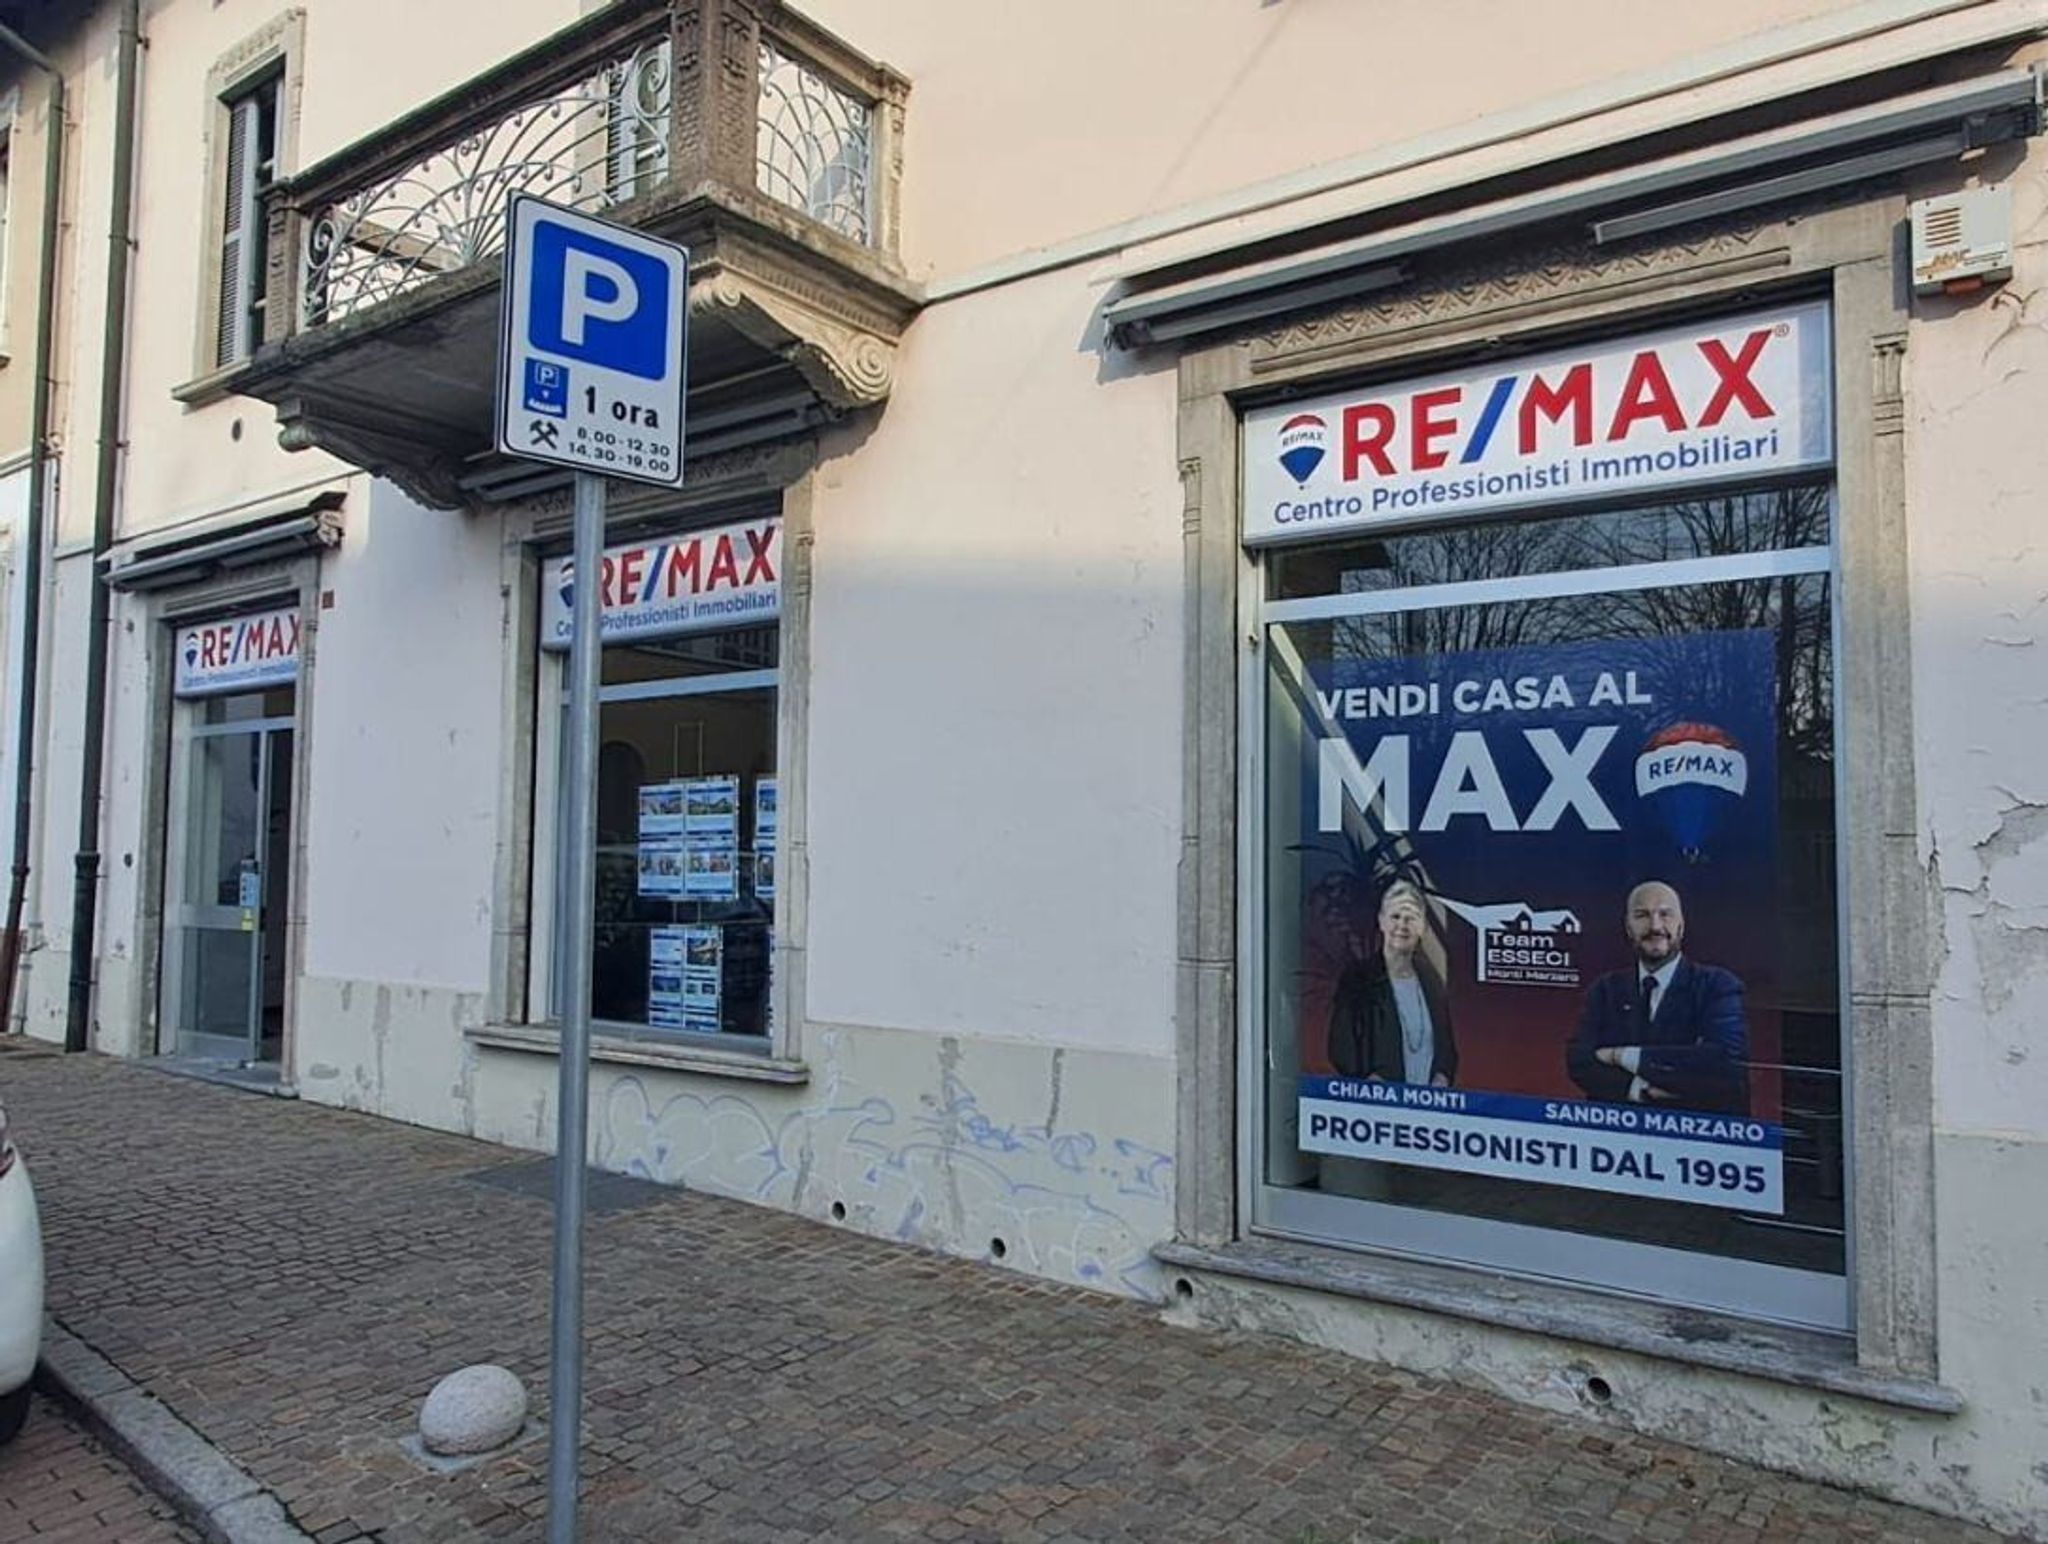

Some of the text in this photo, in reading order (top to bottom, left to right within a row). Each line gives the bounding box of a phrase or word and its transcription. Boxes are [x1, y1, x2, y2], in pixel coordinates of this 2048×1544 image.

[561, 247, 639, 346] P
[584, 386, 659, 429] 1 ora
[1282, 430, 1323, 447] RE/MAX
[1274, 430, 1778, 524] Centro Professionisti Immobiliari
[694, 590, 776, 617] Immobiliari
[1317, 671, 1653, 719] VENDI CASA AL
[1318, 725, 1622, 832] MAX
[1649, 755, 1734, 780] RE/MAX
[1487, 931, 1554, 948] Team
[1328, 1081, 1466, 1109] CHIARA MONTI
[1544, 1103, 1765, 1142] SANDRO MARZARO
[1310, 1114, 1766, 1193] PROFESSIONISTI DAL 1995
